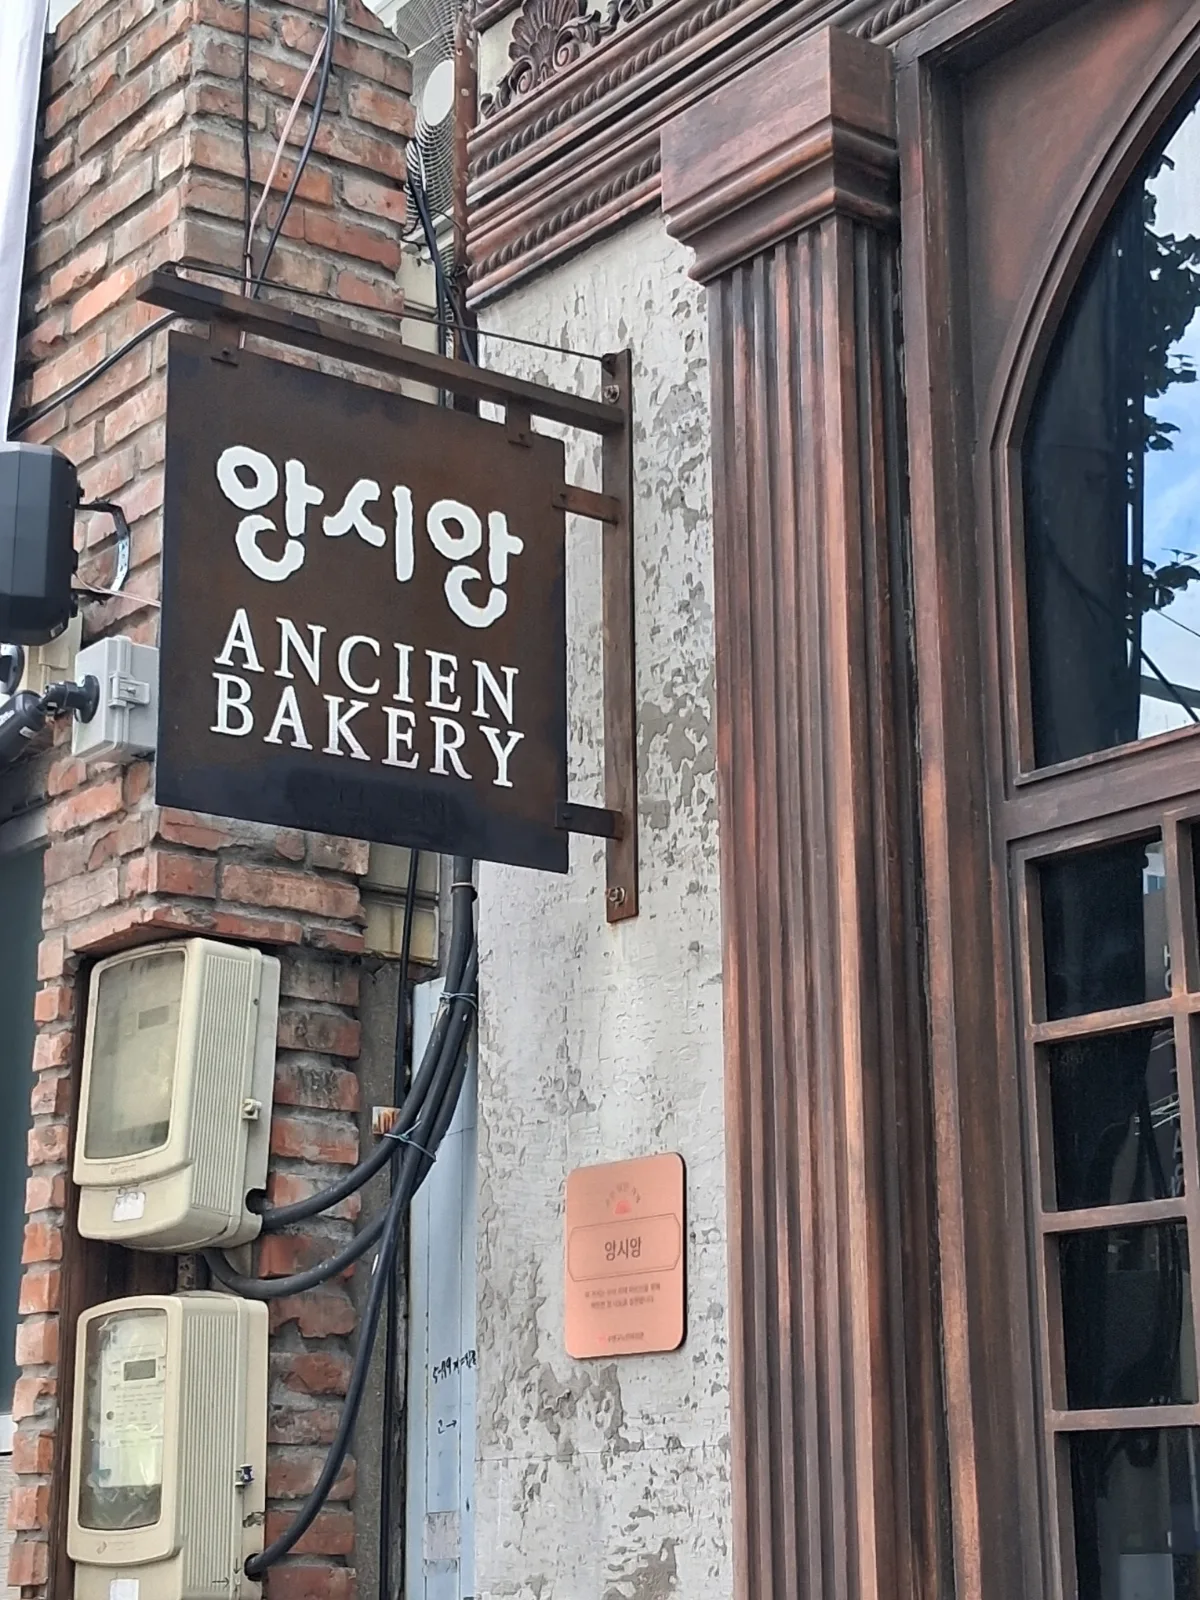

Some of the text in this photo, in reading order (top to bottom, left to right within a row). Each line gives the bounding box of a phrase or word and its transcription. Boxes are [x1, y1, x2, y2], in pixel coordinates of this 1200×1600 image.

[216, 445, 525, 628] 앙시앙
[214, 608, 520, 724] ANCIEN
[209, 671, 525, 788] BAKERY
